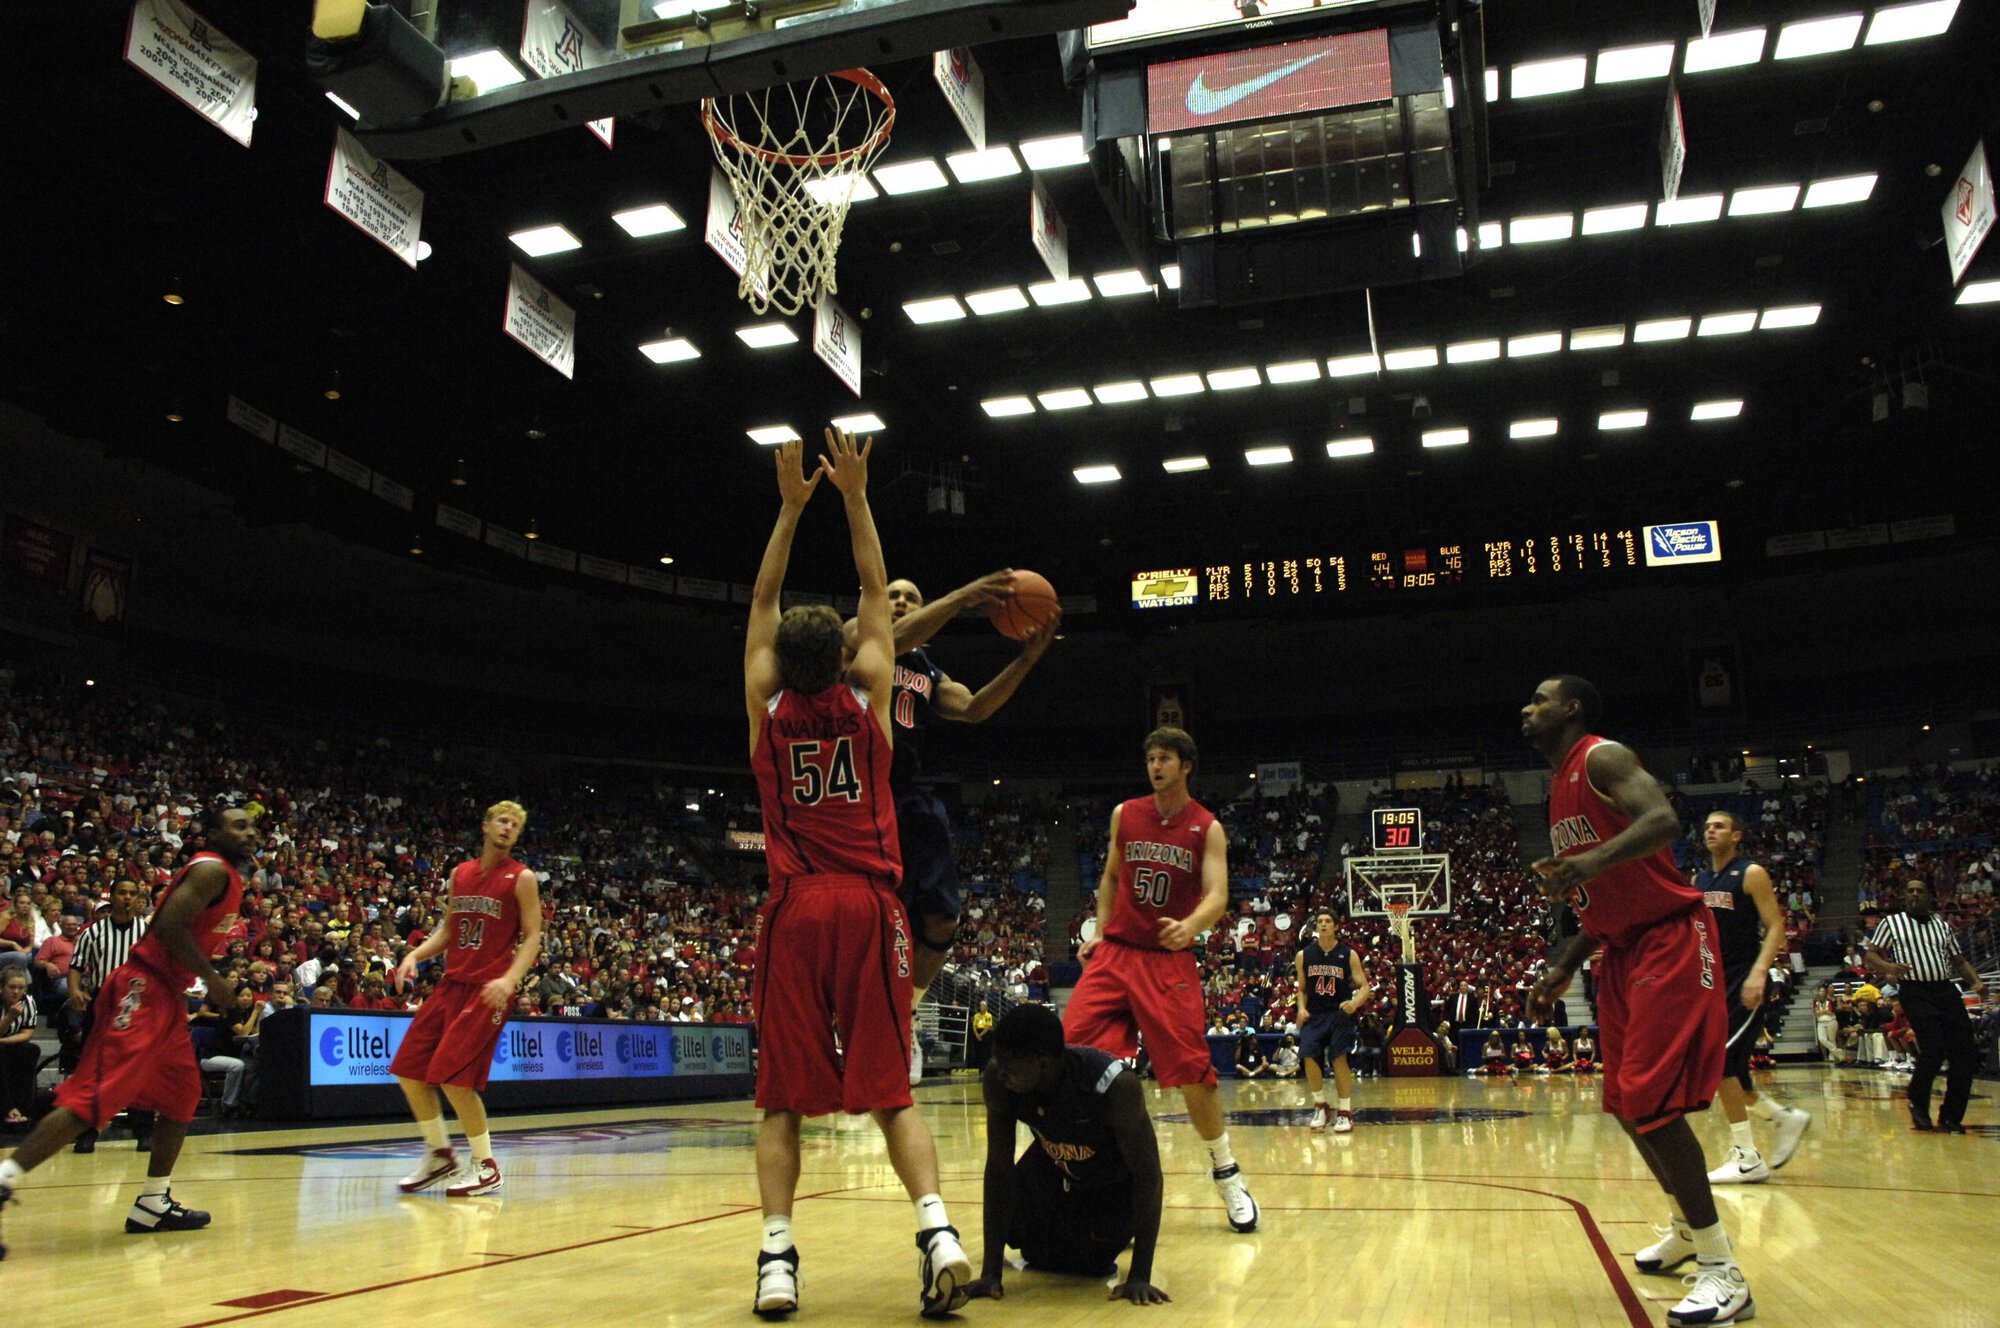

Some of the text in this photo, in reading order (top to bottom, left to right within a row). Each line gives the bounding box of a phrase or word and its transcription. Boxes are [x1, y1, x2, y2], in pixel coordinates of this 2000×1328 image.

[140, 45, 163, 68] 2005
[169, 67, 191, 88] 2006
[154, 33, 236, 98] NCAA TOURNAMENT
[156, 47, 178, 69] 2002
[183, 68, 204, 89] 2003
[346, 177, 408, 226] NCAA TOURNAMENT
[348, 190, 365, 207] 1992
[362, 217, 379, 233] 2000
[1664, 528, 1699, 537] Tucson
[1670, 534, 1706, 545] Electric
[1485, 541, 1511, 552] PLYR
[1550, 536, 1558, 545] 2
[1569, 534, 1583, 544] 12
[1594, 532, 1608, 541] 14
[1617, 530, 1633, 539] 44
[1673, 543, 1708, 552] Power
[1371, 552, 1387, 561] RED
[1440, 546, 1460, 555] BLUE
[1490, 550, 1509, 560] PTS
[1625, 539, 1634, 548] 5
[1244, 563, 1252, 572] 5
[1283, 560, 1298, 569] 34
[1306, 558, 1321, 568] 50
[1329, 556, 1344, 566] 54
[1445, 556, 1462, 569] 46
[1489, 558, 1511, 568] RBS
[1527, 556, 1535, 565] 0
[1552, 554, 1560, 563] 0
[1137, 568, 1191, 581] O'RIELLY
[1210, 574, 1228, 584] PTS
[1267, 570, 1275, 579] 0
[1314, 566, 1322, 575] 4
[1374, 562, 1390, 575] 44
[1490, 567, 1512, 577] FLS
[1528, 565, 1536, 574] 4
[1553, 562, 1561, 571] 0
[1209, 582, 1230, 592] RBS
[1267, 578, 1275, 587] 0
[1291, 577, 1298, 585] 0
[1403, 573, 1435, 587] 19:05
[1268, 587, 1276, 595] 0
[1291, 585, 1299, 594] 0
[1138, 597, 1193, 608] WATSON
[1161, 710, 1180, 723] 32
[789, 737, 863, 807] 54
[1382, 812, 1415, 825] 19:05
[1384, 827, 1411, 847] 30
[1125, 841, 1193, 873] ARIZONA
[1134, 867, 1171, 908] 50
[458, 918, 485, 950] 34
[1307, 964, 1345, 980] ARIZONA
[1315, 975, 1336, 996] 44
[1404, 968, 1416, 1024] ARIZONA
[563, 1005, 582, 1017] POSS.
[1391, 1046, 1434, 1056] WELLS
[512, 1061, 544, 1073] wireless
[576, 1060, 604, 1071] wireless
[633, 1059, 659, 1071] wireless
[1393, 1056, 1434, 1066] FARGO
[349, 1063, 391, 1076] wireless
